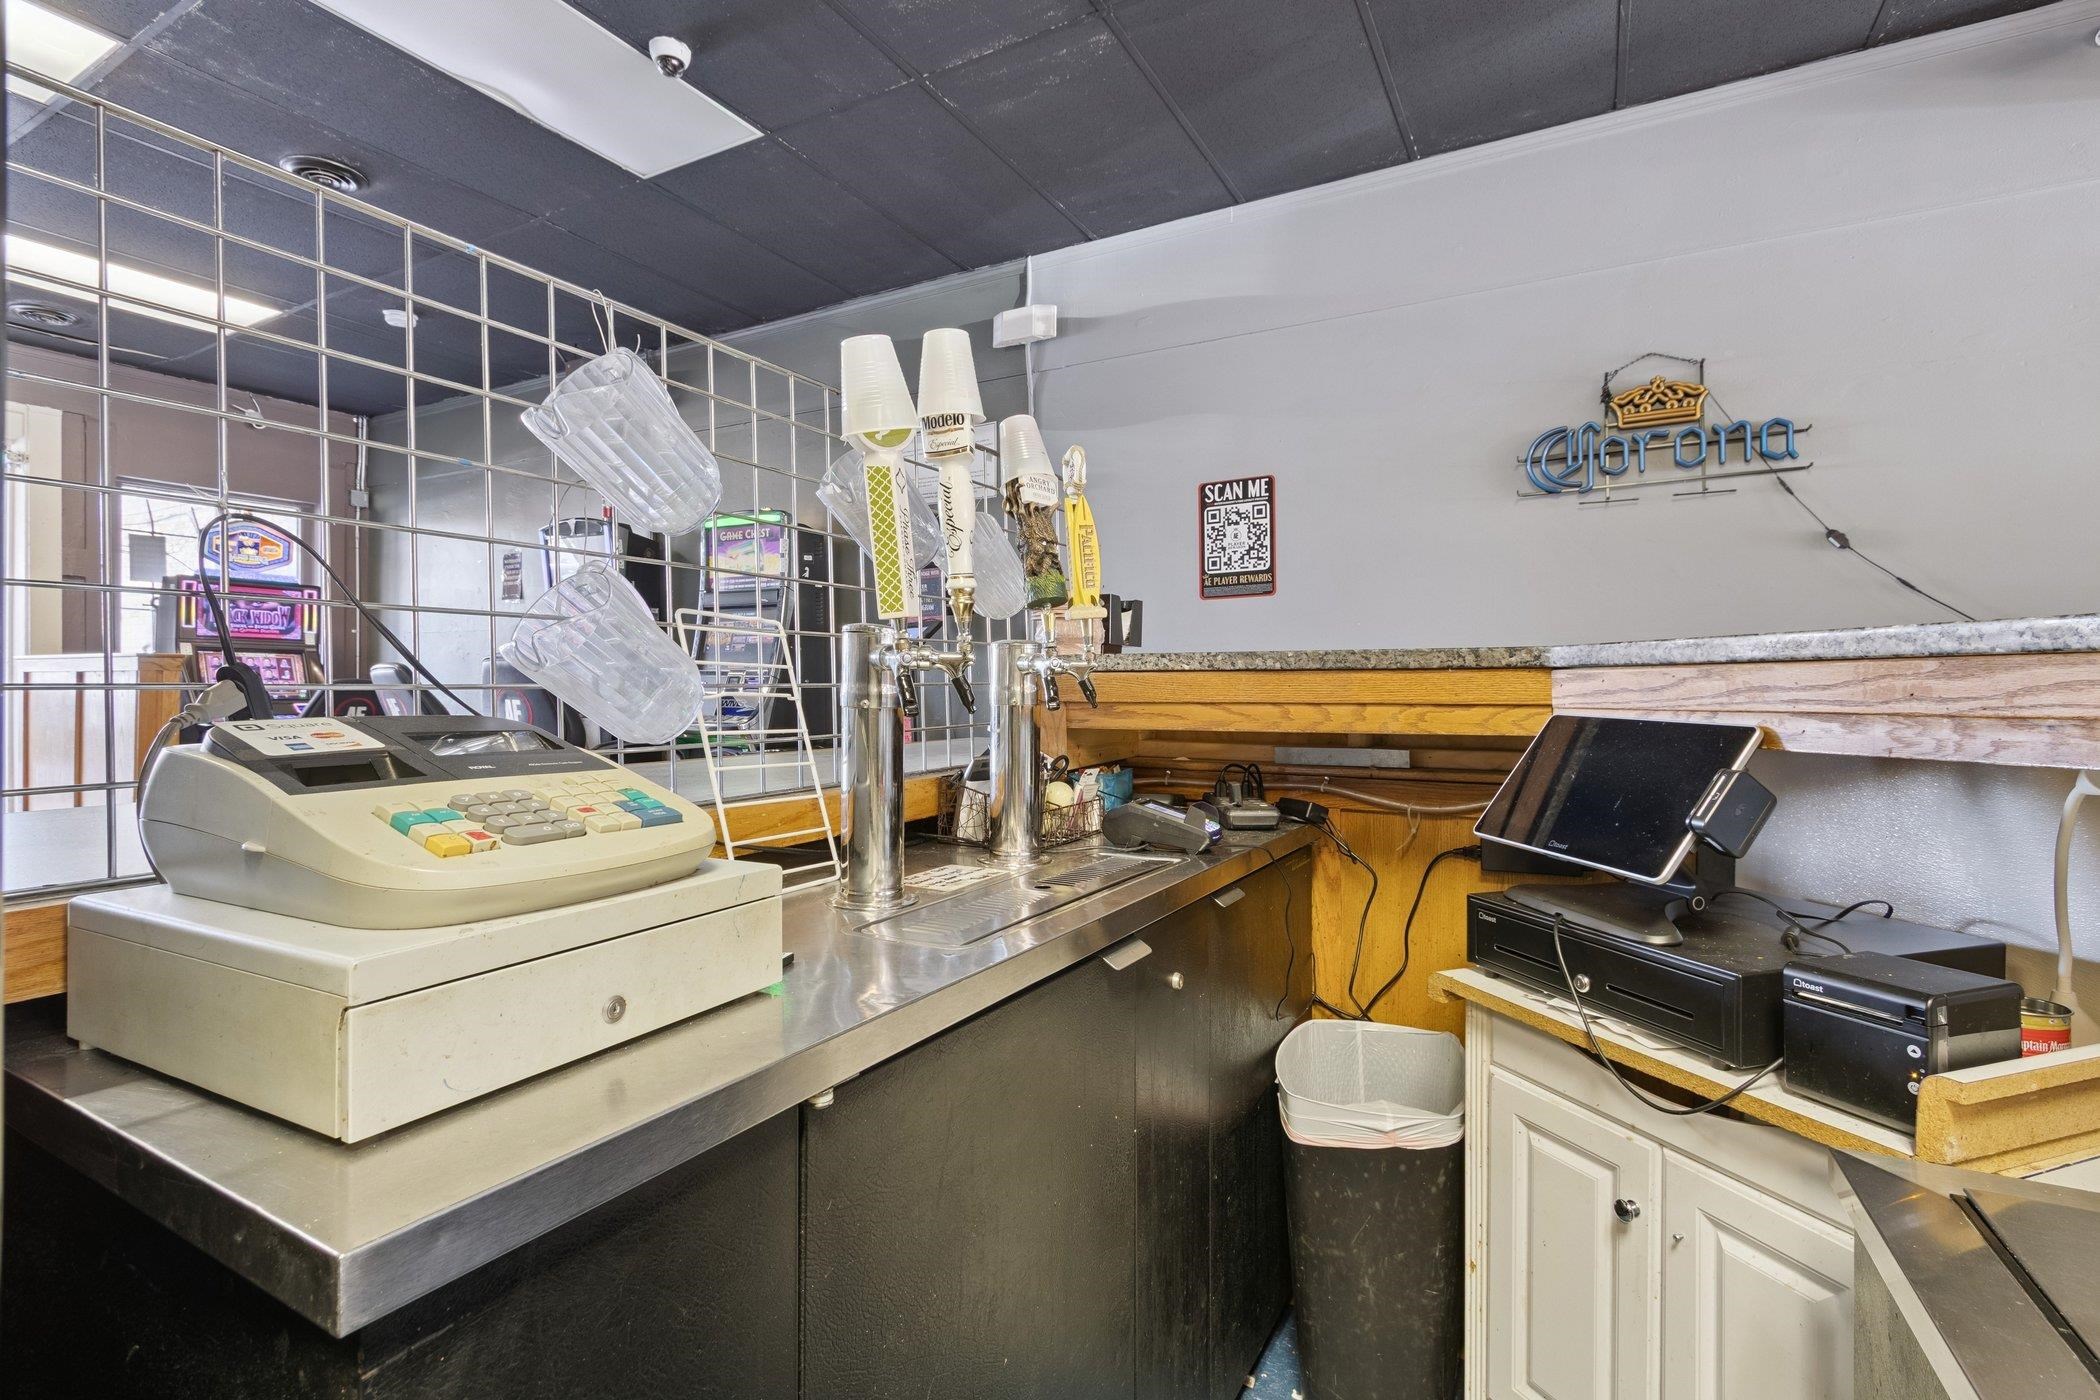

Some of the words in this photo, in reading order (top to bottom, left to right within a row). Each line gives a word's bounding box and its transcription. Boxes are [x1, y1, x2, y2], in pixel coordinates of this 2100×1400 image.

[1525, 417, 1799, 494] Corona
[1028, 476, 1050, 487] ANGRY
[1026, 482, 1056, 495] ORCHARD
[1204, 481, 1243, 503] SCAN
[1248, 478, 1269, 498] ME
[940, 482, 964, 559] Especial
[720, 530, 744, 541] GAME
[1079, 524, 1096, 590] PACIFICO
[1213, 575, 1238, 586] PLAYER
[1240, 572, 1273, 584] REWARDS
[265, 721, 333, 731] Square
[1802, 980, 1824, 993] toast
[2021, 1040, 2049, 1052] ptain
